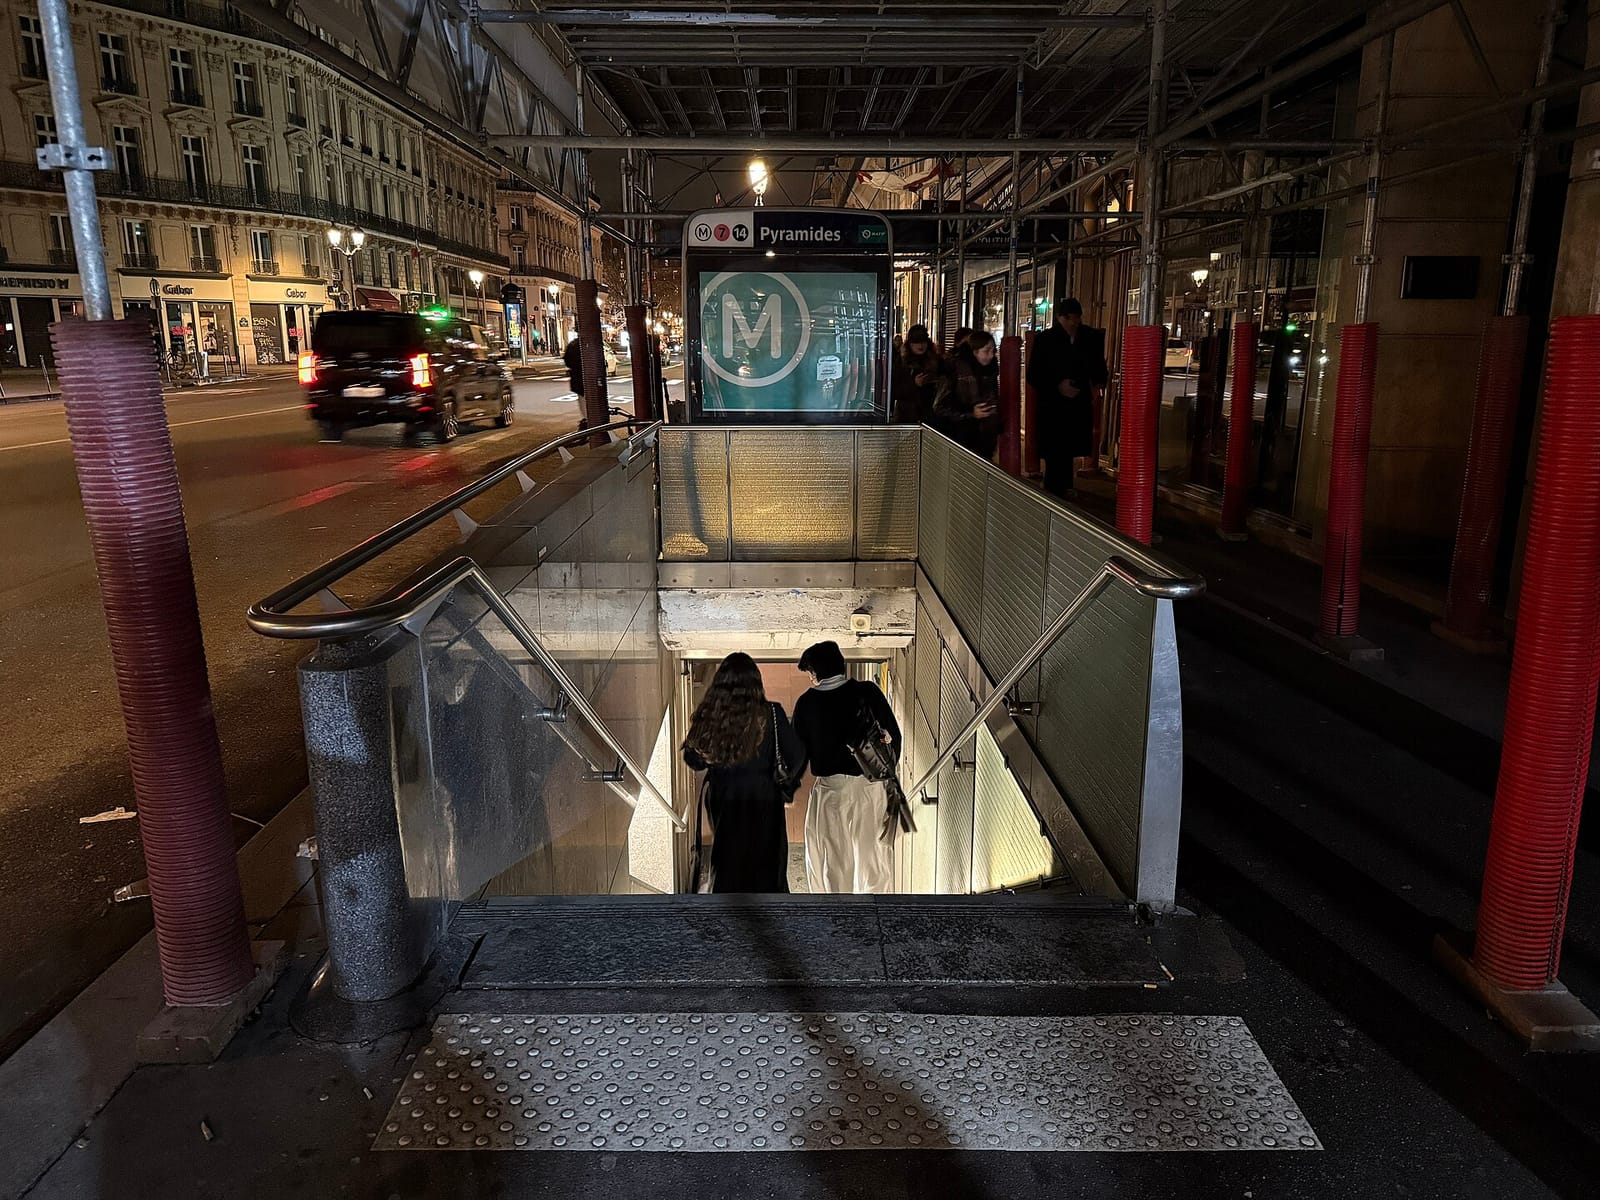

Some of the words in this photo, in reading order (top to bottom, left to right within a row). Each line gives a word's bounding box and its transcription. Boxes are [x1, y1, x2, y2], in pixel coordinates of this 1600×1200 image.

[697, 227, 708, 238] M
[718, 227, 726, 238] 7
[733, 227, 748, 238] 14
[760, 226, 841, 244] Pyramides
[162, 284, 194, 295] Gabor
[286, 288, 307, 298] Gabor
[721, 293, 782, 359] M
